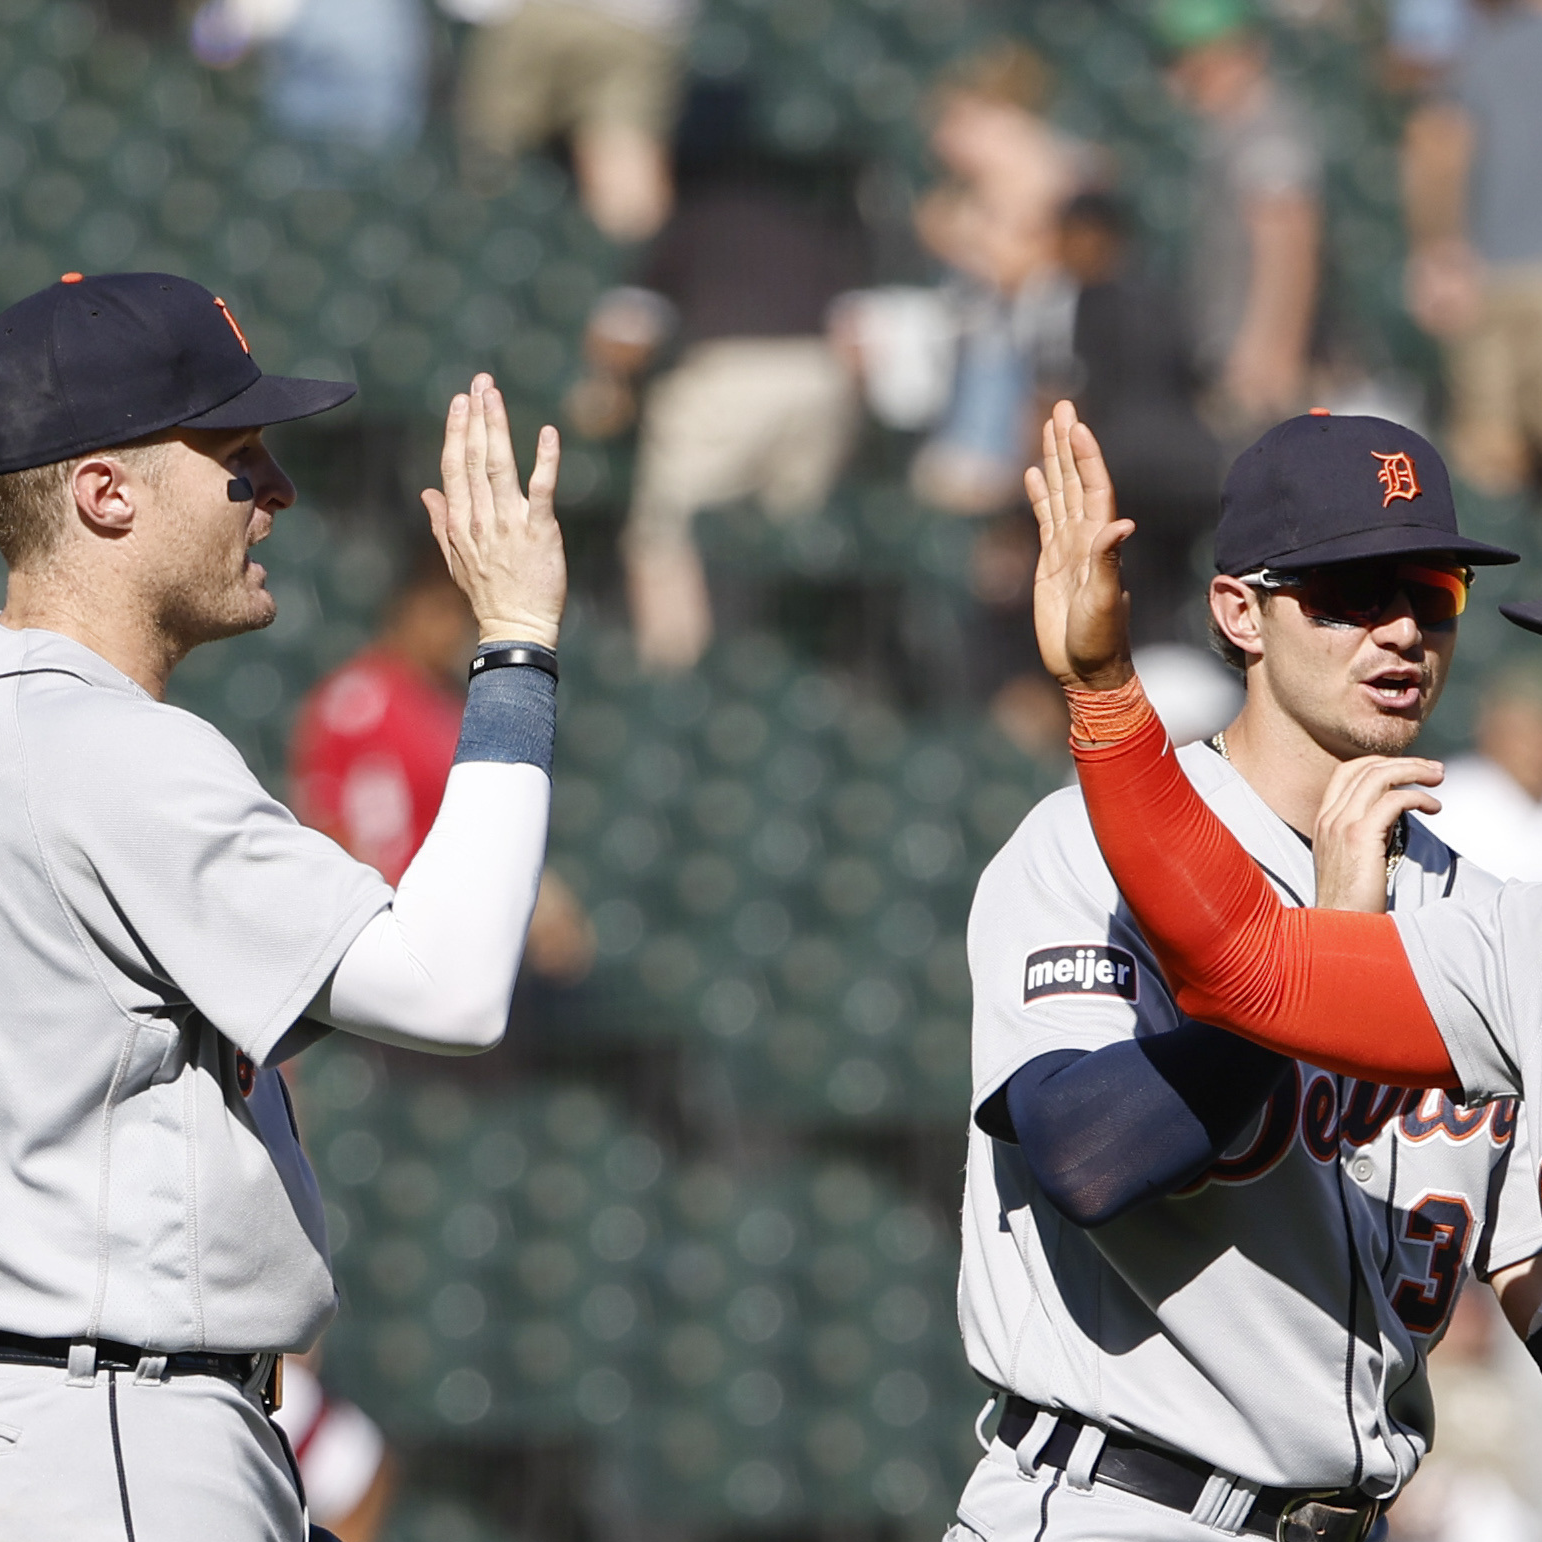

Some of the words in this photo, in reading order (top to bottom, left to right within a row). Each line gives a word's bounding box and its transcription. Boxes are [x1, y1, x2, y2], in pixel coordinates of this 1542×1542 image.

[1370, 450, 1422, 508] D
[1027, 949, 1131, 991] meijer
[1388, 1188, 1485, 1340] 3
